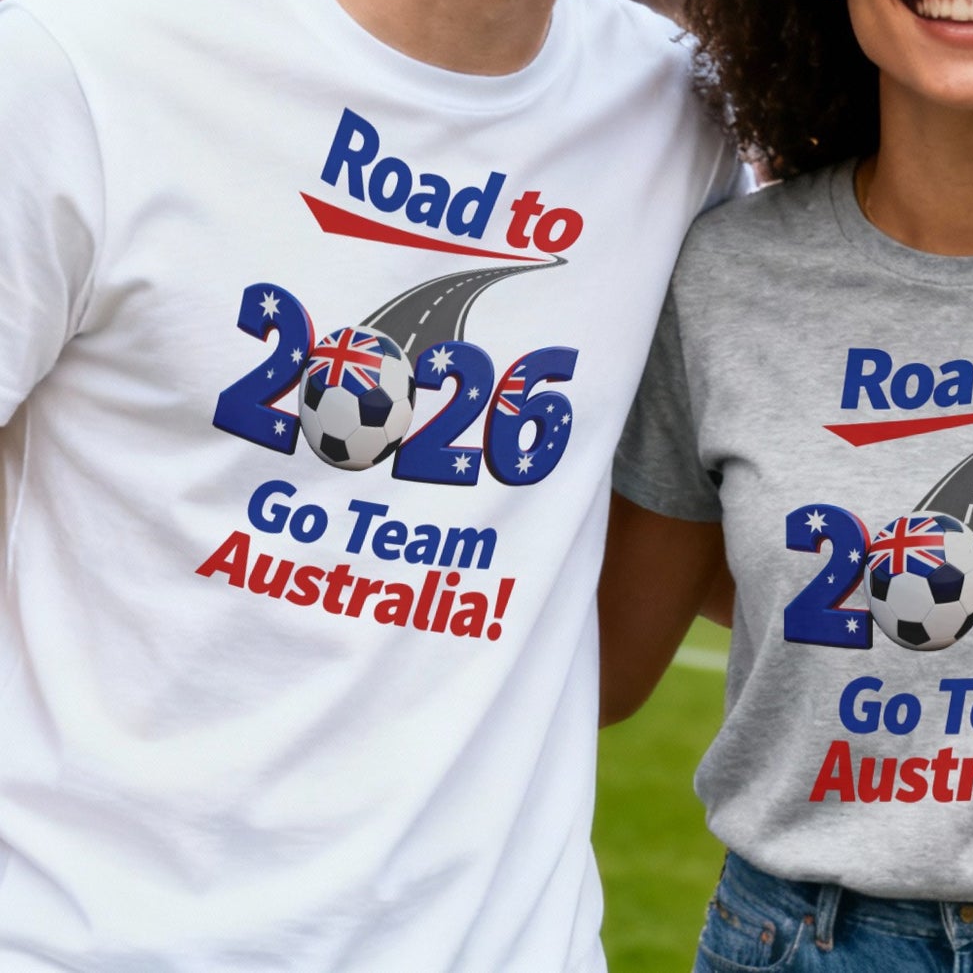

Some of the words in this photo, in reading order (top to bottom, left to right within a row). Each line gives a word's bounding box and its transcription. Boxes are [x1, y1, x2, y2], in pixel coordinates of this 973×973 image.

[320, 107, 507, 240] Road
[504, 191, 584, 253] to
[247, 479, 328, 543] Go
[347, 499, 498, 569] Team
[195, 530, 516, 641] Australia!
[838, 675, 922, 736] Go
